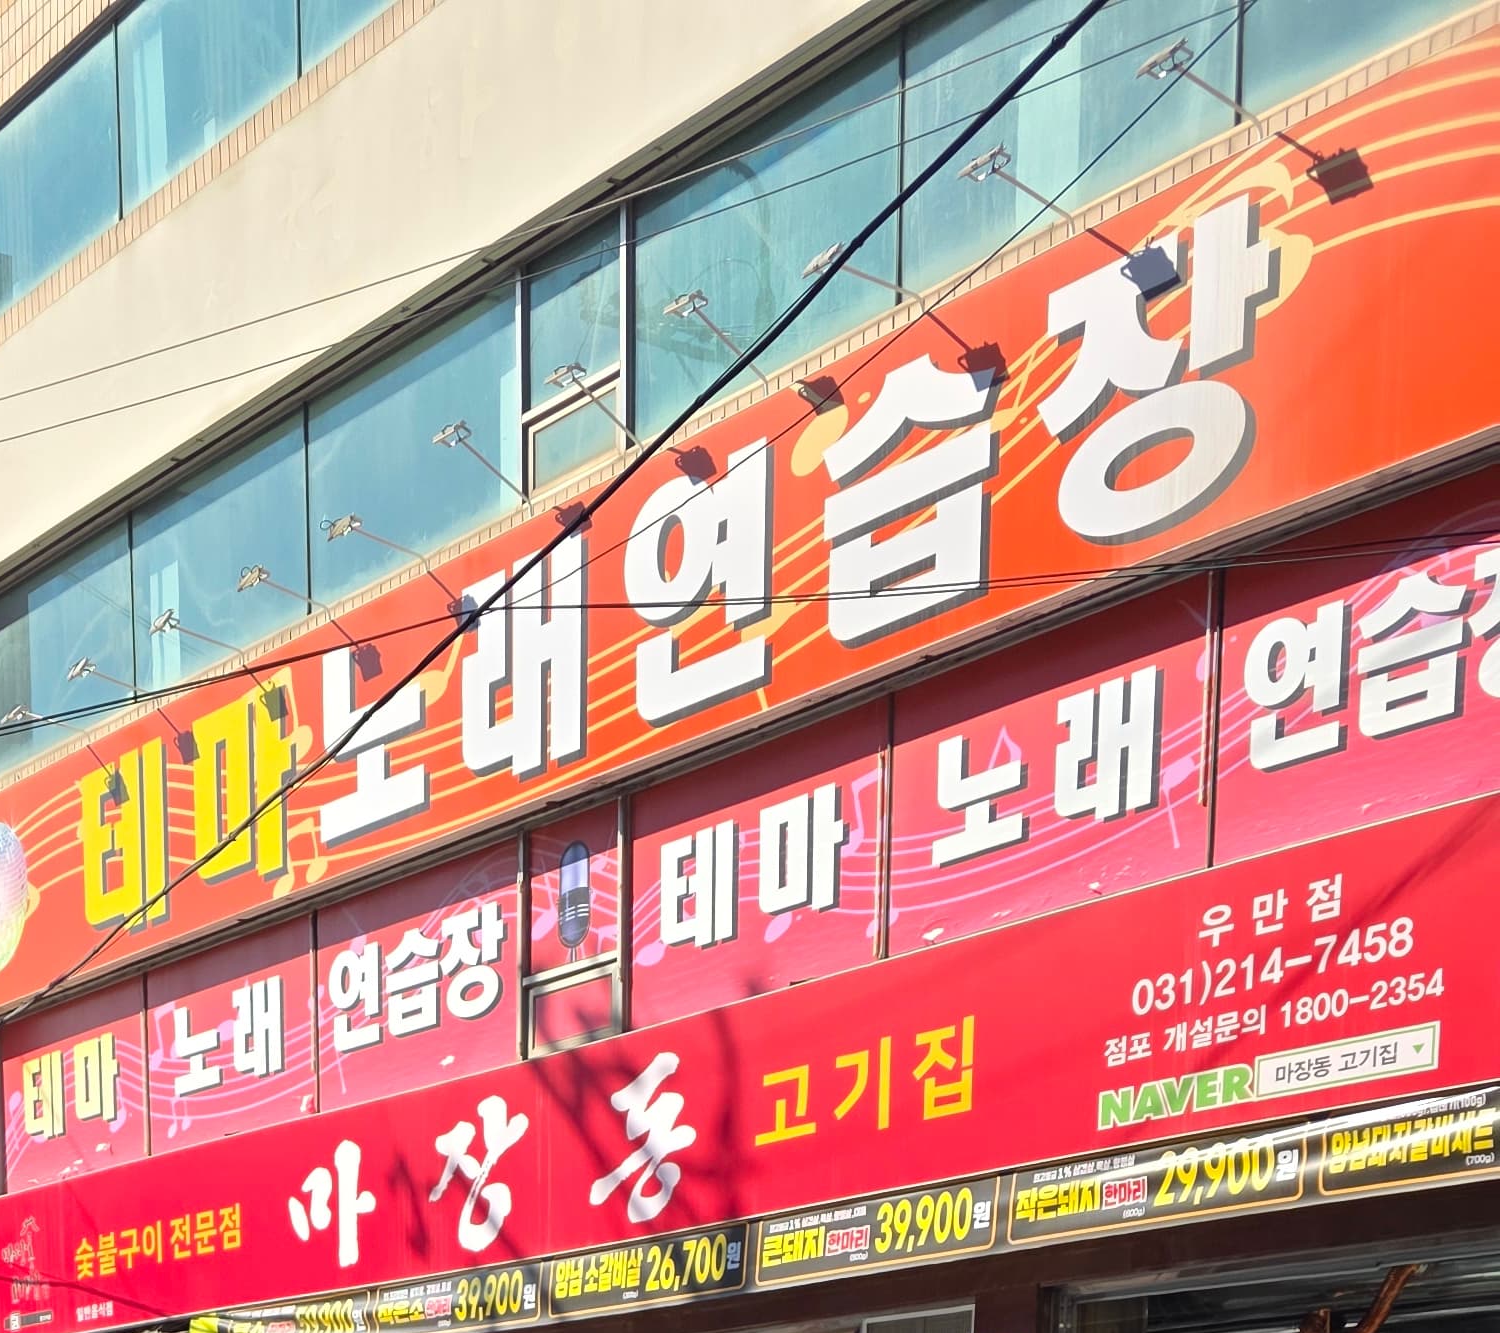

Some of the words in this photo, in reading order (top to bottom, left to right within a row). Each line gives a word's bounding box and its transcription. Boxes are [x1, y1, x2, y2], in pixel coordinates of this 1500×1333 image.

[660, 777, 852, 950] 테마
[932, 665, 1167, 872] 노래
[1130, 916, 1416, 1017] 031)214-7458
[22, 1030, 121, 1140] 테마
[172, 974, 286, 1098] 노래
[327, 901, 507, 1052] 연습장
[1103, 1031, 1153, 1068] 점포
[1163, 1003, 1268, 1053] 개설문의
[1279, 967, 1446, 1029] 1800-2354
[1098, 1062, 1254, 1131] NAVER
[1274, 1054, 1333, 1085] 마장동
[1337, 1040, 1399, 1072] 고기집
[73, 1220, 164, 1281] 숯불구이
[168, 1201, 242, 1261] 전문점
[286, 1049, 698, 1269] 마장동
[752, 1013, 977, 1148] 고기집
[1015, 1176, 1101, 1223] 작은돼지
[1103, 1177, 1147, 1209] 한마리
[555, 1257, 583, 1300] 양념
[584, 1247, 643, 1293] 소갈비살
[762, 1226, 826, 1269] 큰돼지
[827, 1226, 870, 1256] 한마리
